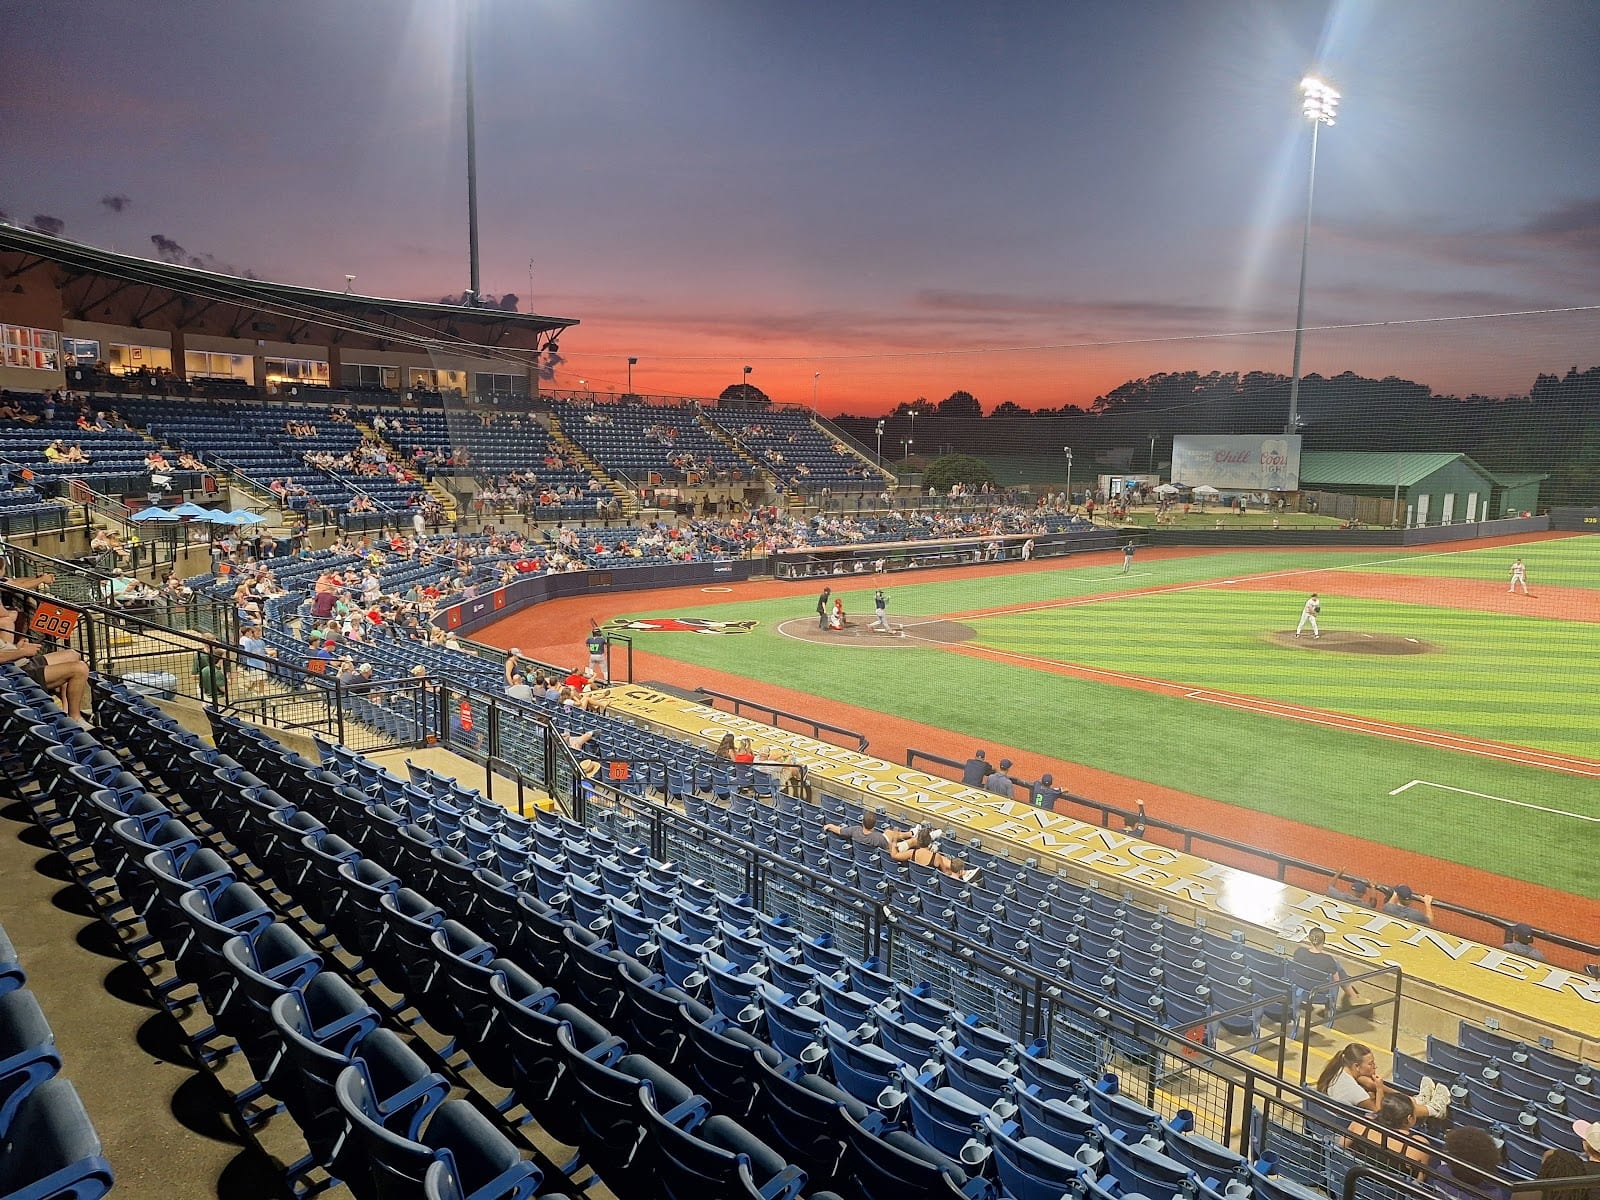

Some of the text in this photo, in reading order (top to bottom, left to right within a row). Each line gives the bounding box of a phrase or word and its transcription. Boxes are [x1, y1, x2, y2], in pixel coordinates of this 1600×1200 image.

[1215, 450, 1250, 463] Chill
[36, 613, 71, 635] 209
[679, 704, 892, 771] PREFERRED
[896, 771, 1182, 866] CLEANING
[832, 770, 989, 823] ROME
